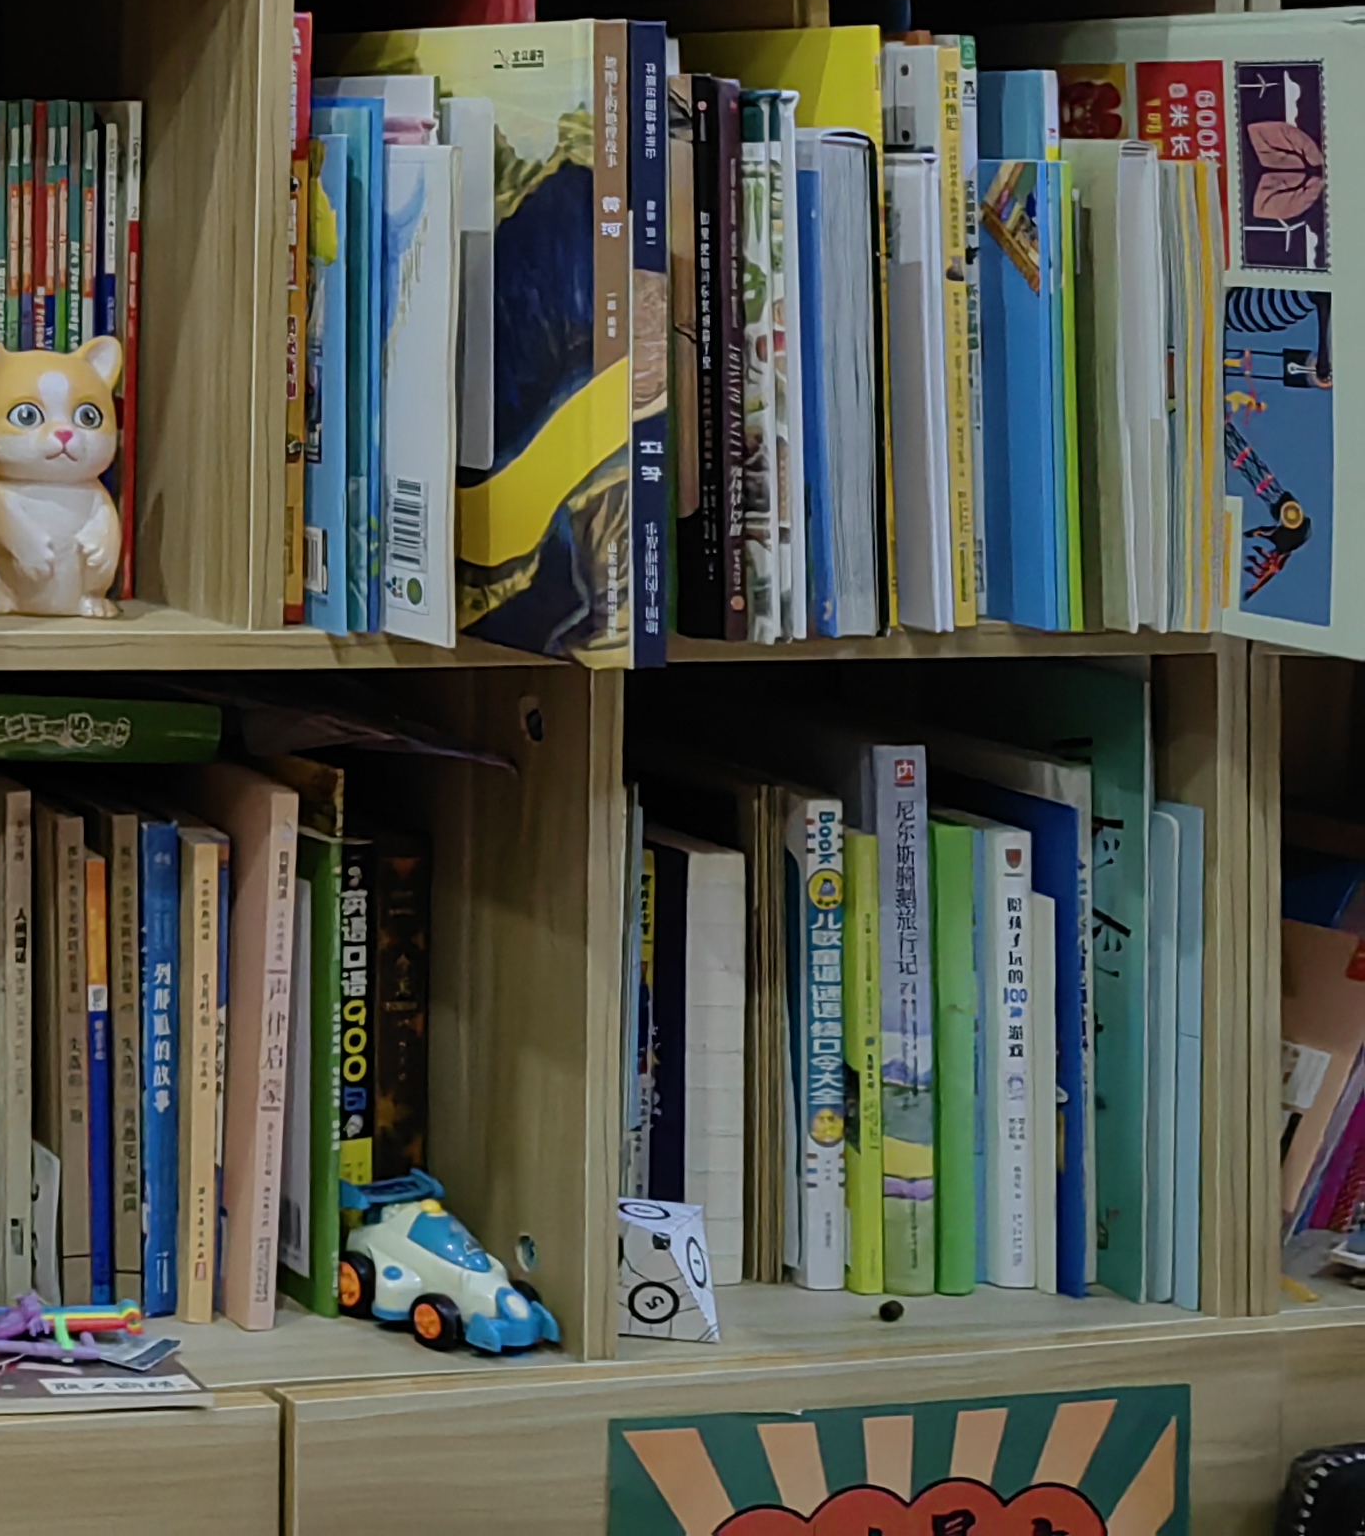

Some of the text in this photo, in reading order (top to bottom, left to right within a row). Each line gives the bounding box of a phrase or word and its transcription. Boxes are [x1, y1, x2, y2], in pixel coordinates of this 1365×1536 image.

[601, 196, 622, 238] 黄河
[818, 811, 836, 865] Book
[895, 800, 918, 976] 尼尔斯骑鹅旅行记
[14, 908, 27, 964] 人间词话
[343, 889, 368, 1112] 英语口语900句
[153, 962, 171, 1113] 列那狐的故事
[261, 976, 288, 1105] 声律启蒙
